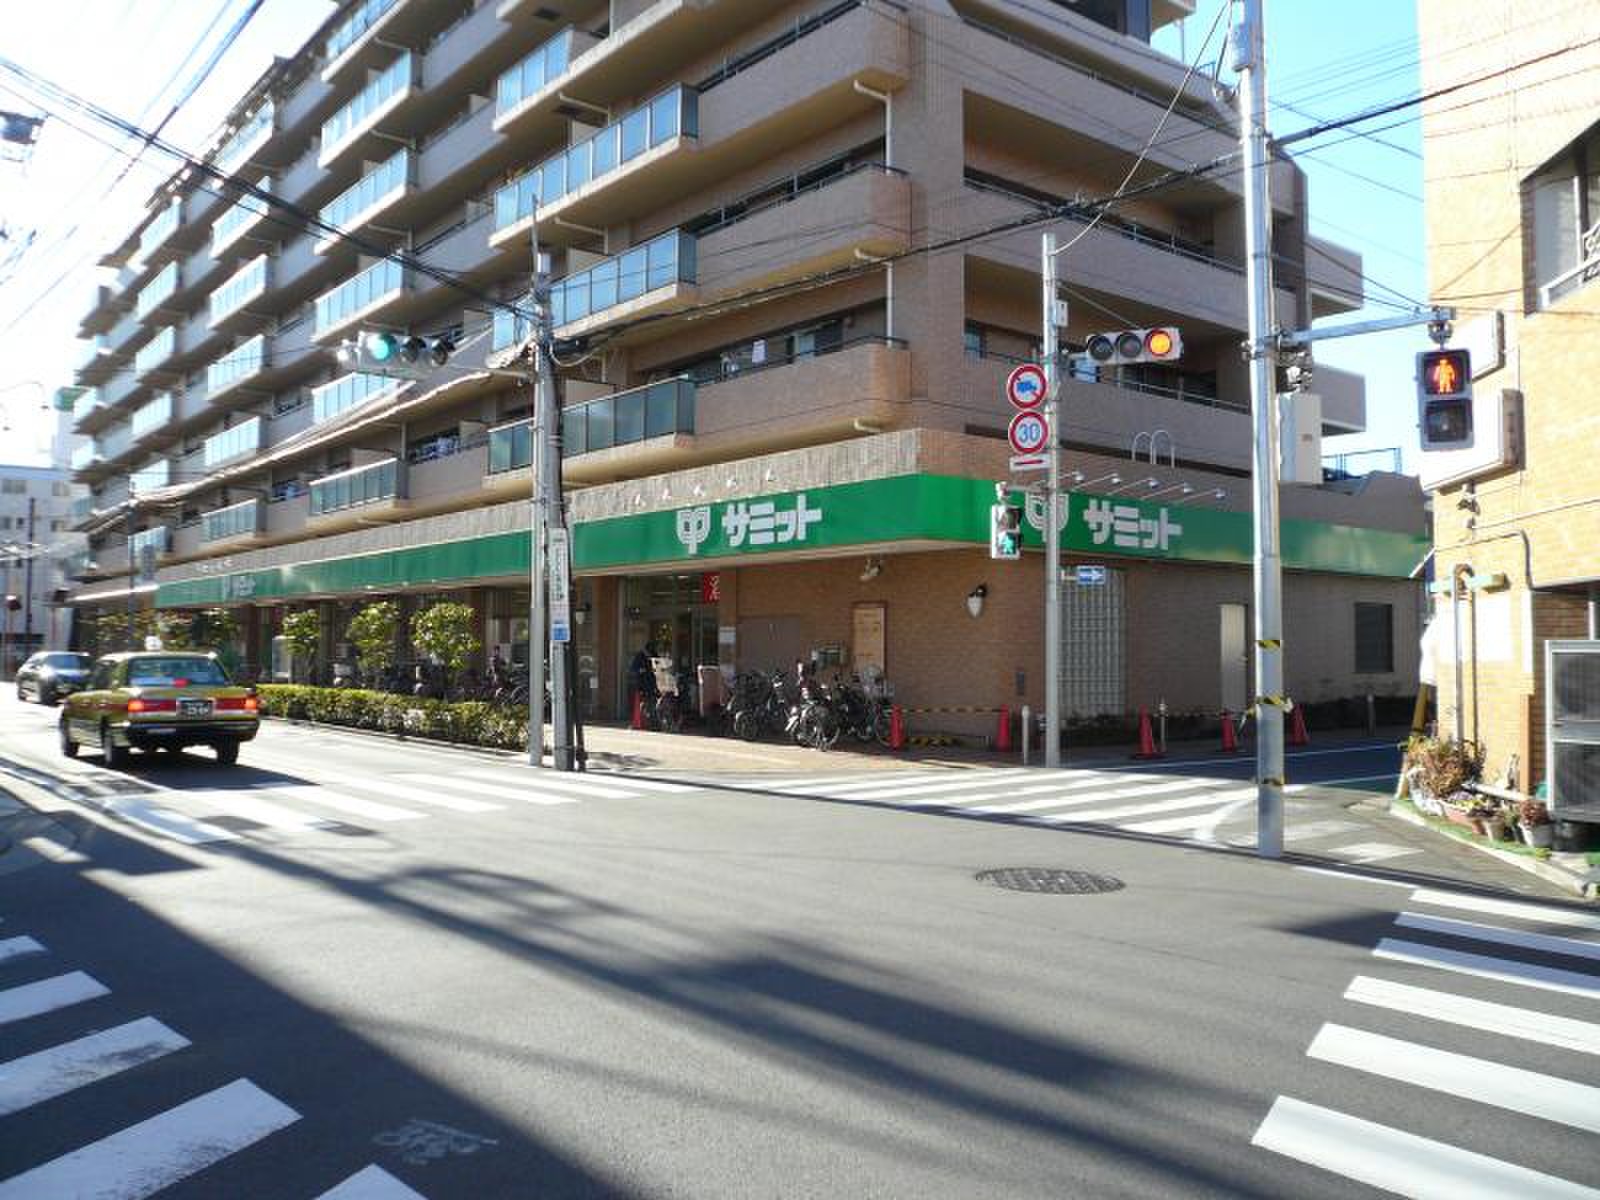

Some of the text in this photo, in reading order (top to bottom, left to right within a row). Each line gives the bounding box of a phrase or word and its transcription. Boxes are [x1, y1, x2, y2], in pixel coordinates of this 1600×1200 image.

[1017, 422, 1041, 443] 30
[721, 492, 823, 547] サミット
[1082, 498, 1183, 551] サミット
